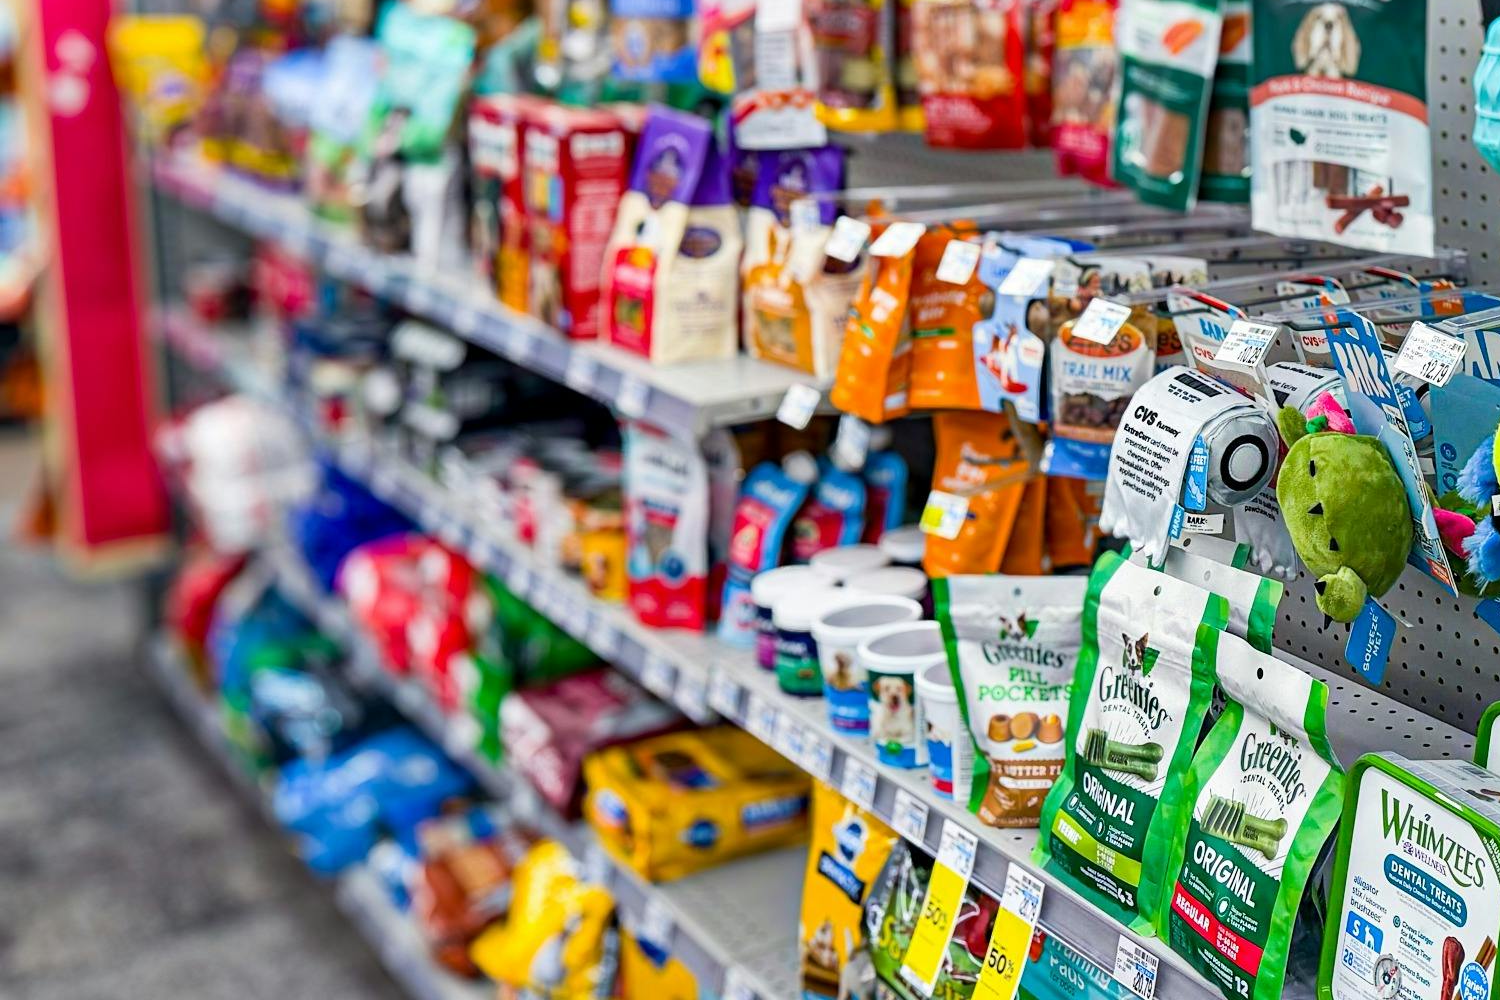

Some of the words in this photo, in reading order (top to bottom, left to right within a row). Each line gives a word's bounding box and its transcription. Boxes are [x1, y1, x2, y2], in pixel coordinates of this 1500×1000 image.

[1103, 365, 1132, 383] MIX
[1134, 406, 1158, 425] CVS
[1125, 438, 1146, 452] presented
[1147, 447, 1152, 455] to
[1153, 451, 1170, 463] redeem
[1151, 438, 1161, 448] card
[1160, 444, 1172, 453] must
[1151, 460, 1162, 471] Offer
[1154, 473, 1170, 487] savings
[1363, 614, 1380, 672] SQUEEZE
[1372, 627, 1382, 658] ME!
[982, 639, 1068, 668] Greenies
[1008, 667, 1048, 685] PILL
[1099, 664, 1171, 731] Greenies
[1240, 732, 1304, 805] Greenies
[1241, 774, 1267, 789] DENTAL
[1082, 771, 1136, 826] ORIGINAL
[1414, 848, 1447, 878] WELLNESS
[1193, 840, 1256, 908] ORIGINAL
[1352, 887, 1363, 898] stix
[1354, 875, 1379, 896] alligator
[1391, 861, 1427, 891] DENTAL
[1430, 883, 1462, 914] TREATS
[1176, 893, 1210, 932] REGULAR
[1353, 920, 1360, 936] S
[1418, 931, 1434, 946] Longer
[1400, 937, 1419, 956] Cleaning
[1343, 949, 1354, 967] 28
[1235, 976, 1249, 998] 12
[1464, 973, 1487, 997] Variety
